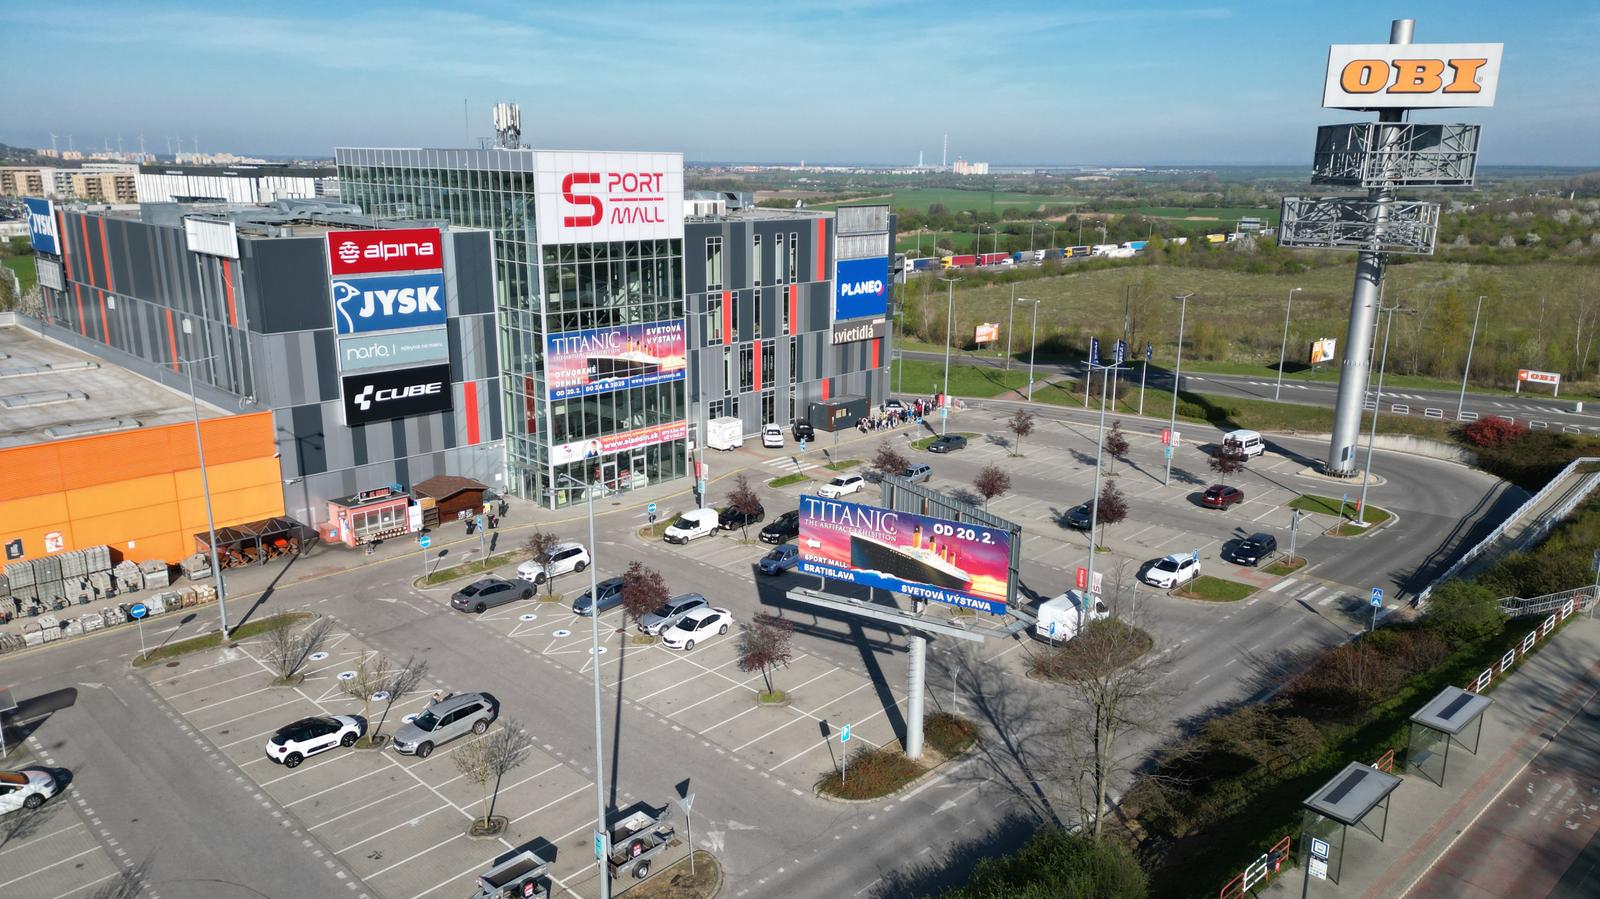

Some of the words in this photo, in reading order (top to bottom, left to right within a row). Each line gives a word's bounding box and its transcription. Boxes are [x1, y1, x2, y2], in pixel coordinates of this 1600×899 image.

[1340, 59, 1488, 94] OBI
[33, 213, 54, 237] JYSK
[610, 206, 665, 225] MALL
[364, 240, 434, 262] alpina
[841, 280, 883, 297] PLANEO
[359, 286, 442, 318] JYSK
[646, 322, 681, 336] SVETOVÁ
[834, 323, 874, 344] svietidlá
[552, 331, 620, 355] TITANIC
[646, 333, 681, 345] VÝSTAVA
[554, 364, 597, 378] OTVORENÉ
[375, 382, 442, 402] CUBE
[555, 377, 582, 388] DENNE
[603, 432, 658, 449] www.aladdin.sk
[805, 498, 898, 535] TITANIC
[805, 519, 818, 527] THE
[933, 523, 954, 537] OD
[956, 527, 980, 542] 20.
[982, 532, 996, 545] 2.
[804, 554, 827, 564] SPORT
[828, 559, 848, 569] MALL
[804, 563, 855, 581] BRATISLAVA
[901, 584, 945, 601] SVETOVÁ
[946, 593, 991, 611] VÝSTAVA
